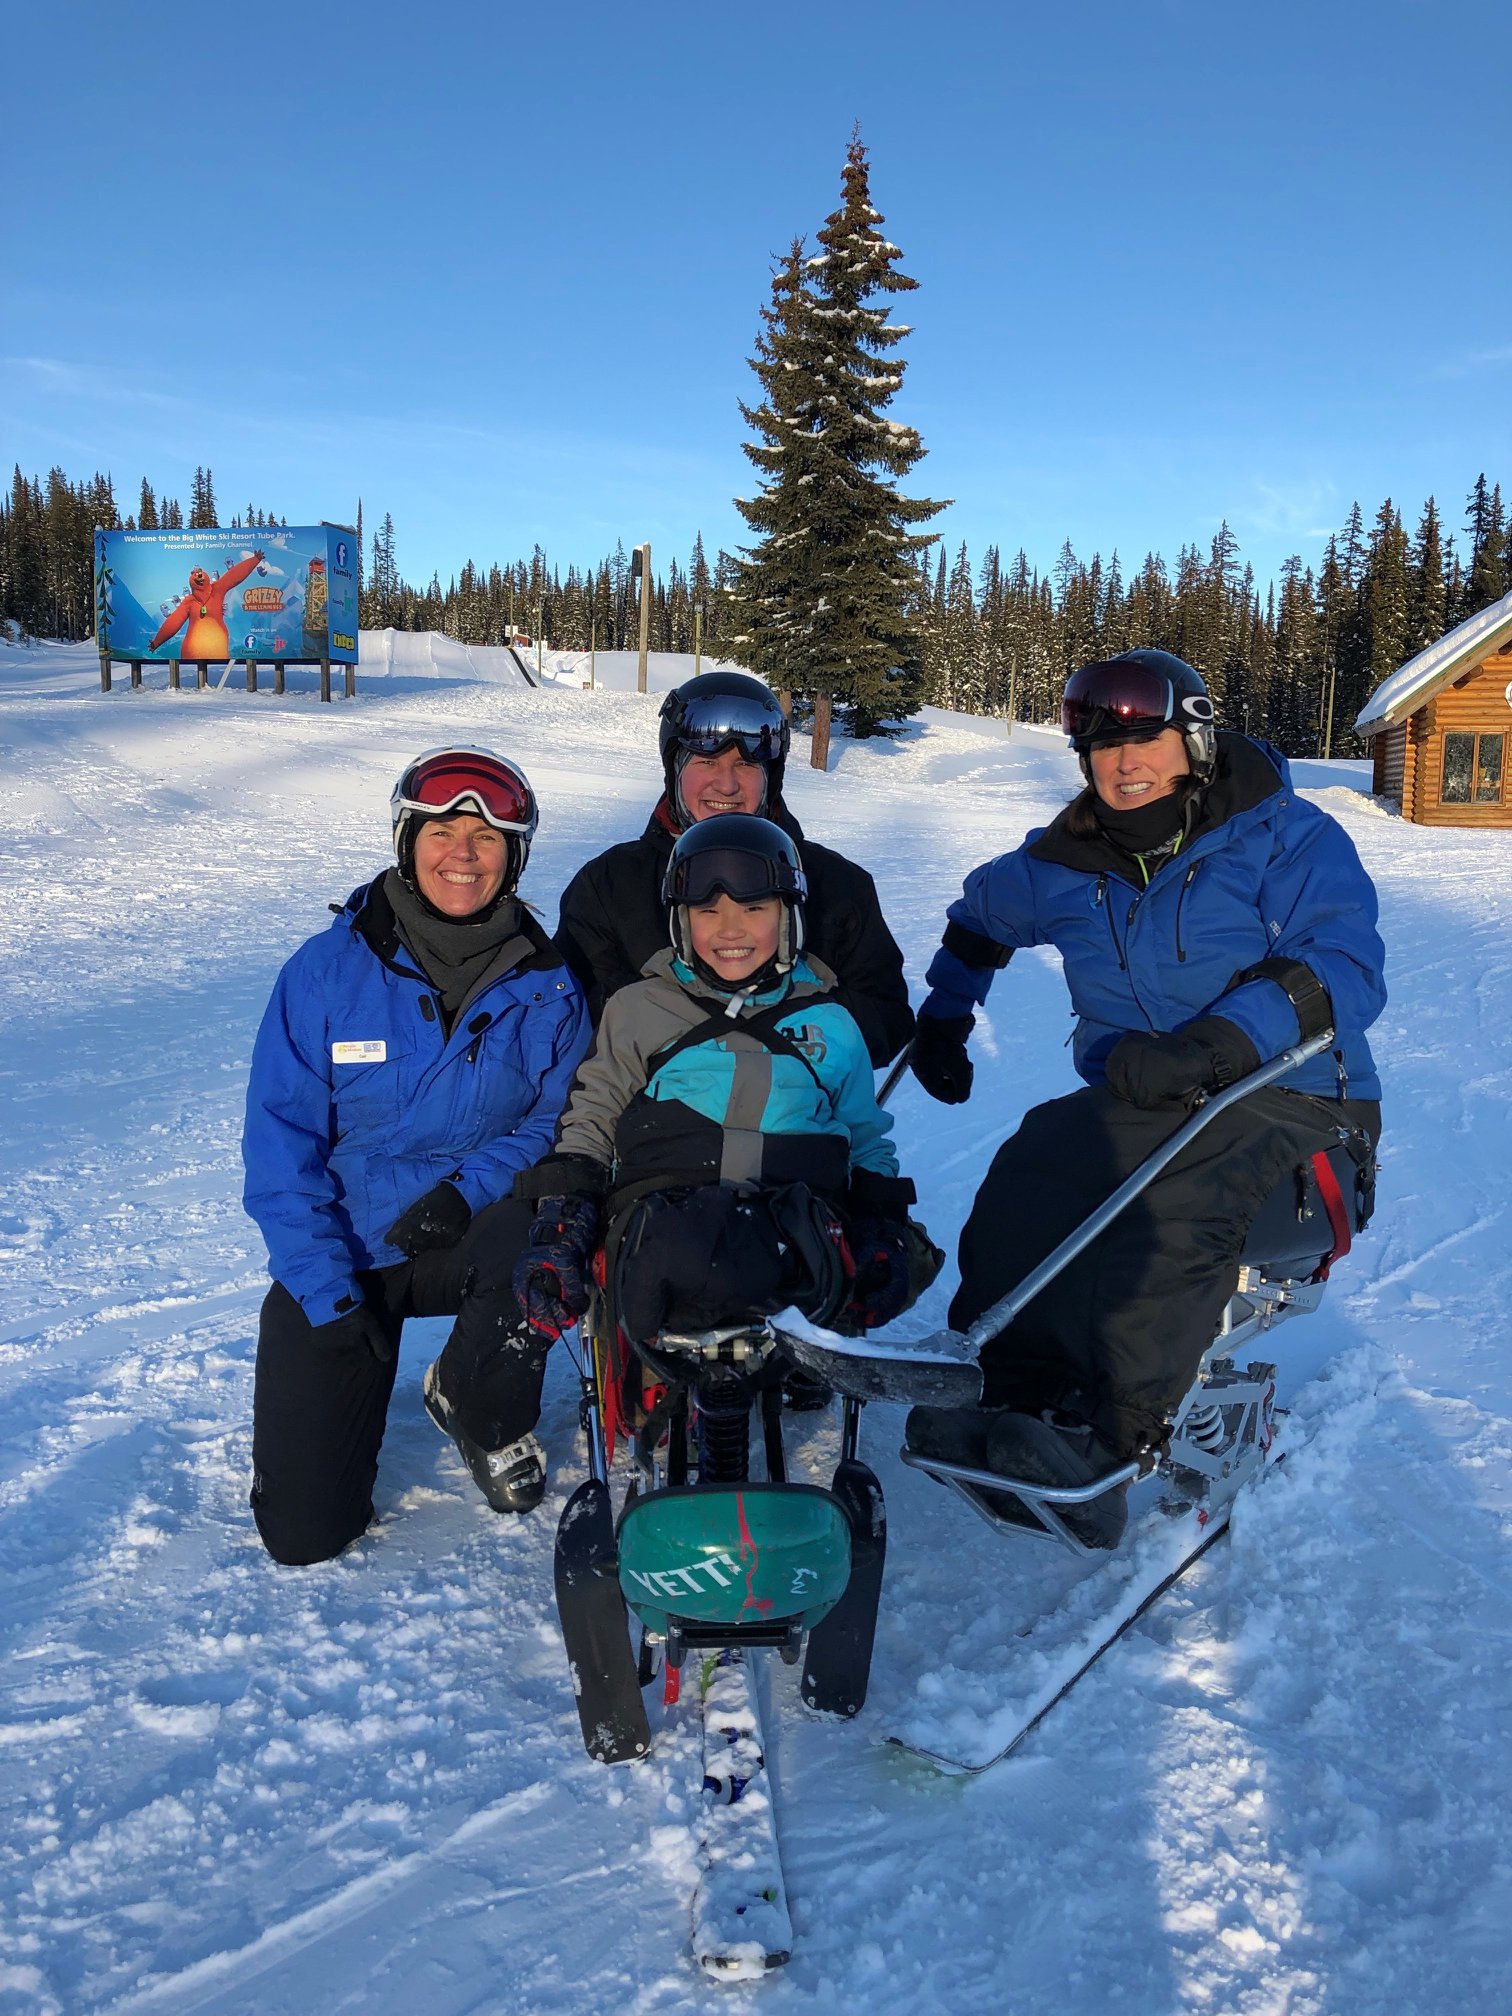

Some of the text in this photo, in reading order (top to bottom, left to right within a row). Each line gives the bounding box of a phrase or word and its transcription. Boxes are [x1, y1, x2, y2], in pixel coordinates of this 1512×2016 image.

[124, 535, 157, 543] Welcome
[168, 534, 181, 542] the
[182, 534, 194, 543] Big
[195, 533, 217, 541] White
[231, 532, 255, 540] Resort
[205, 541, 226, 549] Family
[333, 566, 353, 581] family
[244, 588, 283, 604] GRIZZY
